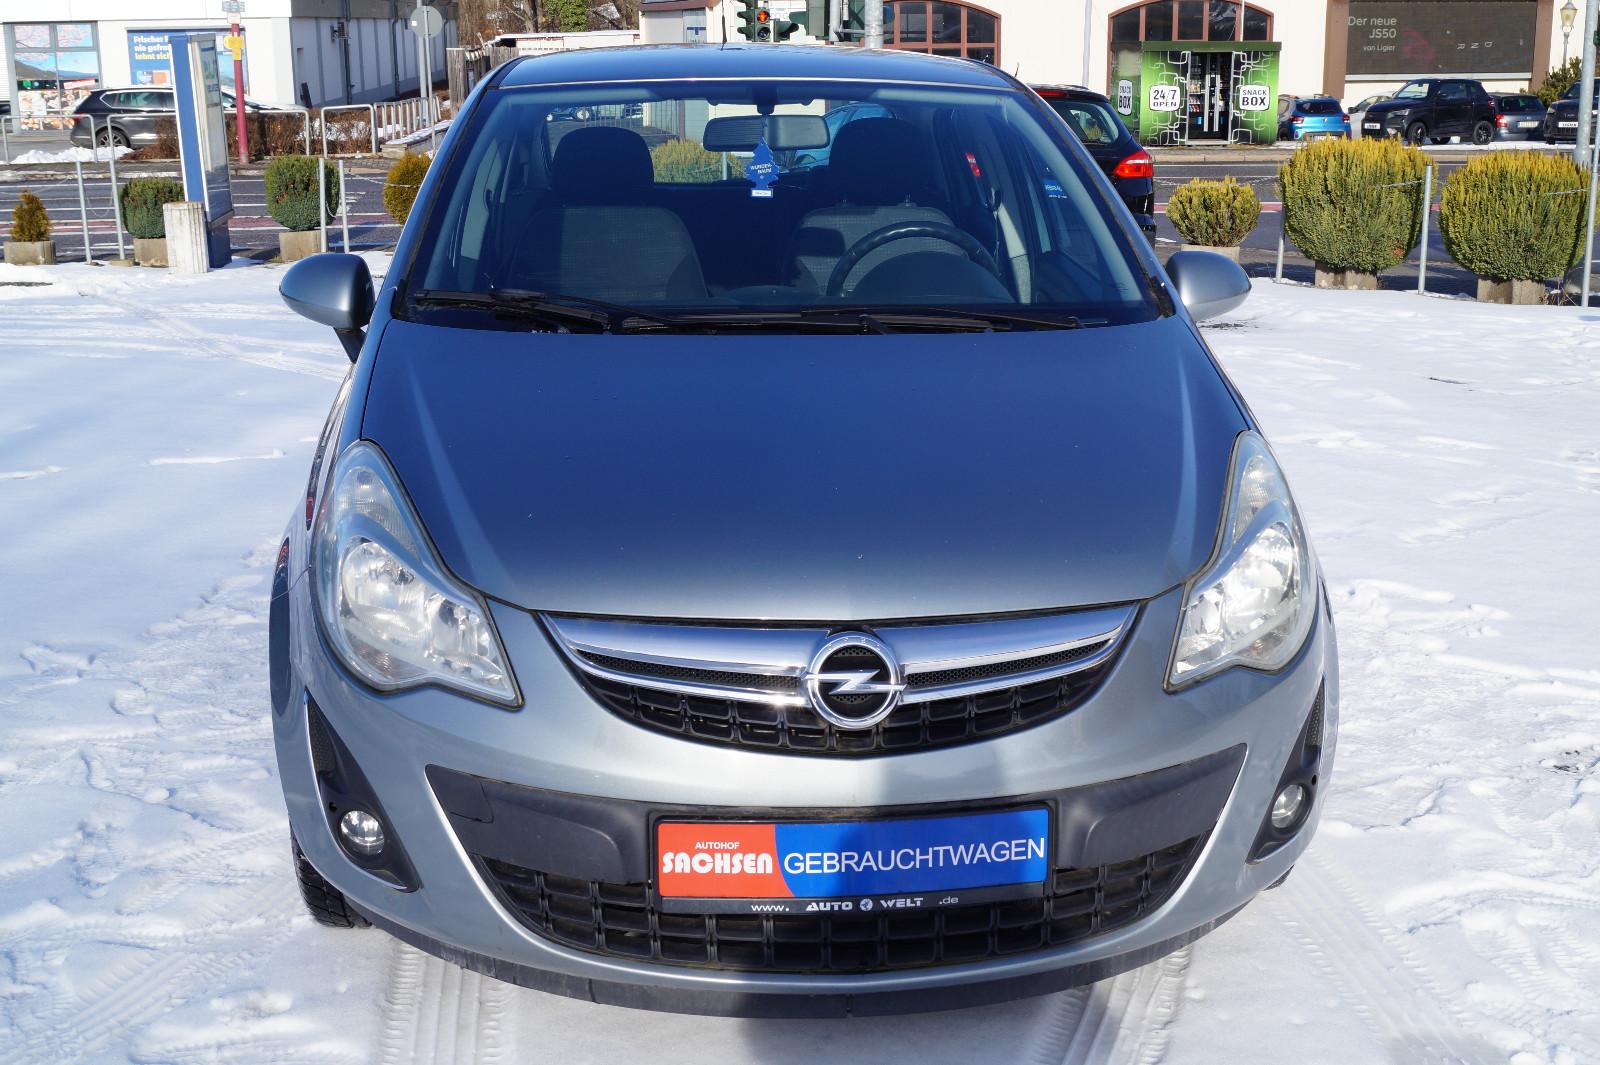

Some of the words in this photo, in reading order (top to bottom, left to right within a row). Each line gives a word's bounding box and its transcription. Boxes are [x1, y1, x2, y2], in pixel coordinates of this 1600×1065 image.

[1348, 16, 1367, 26] Der
[1370, 18, 1397, 26] neue
[133, 35, 164, 43] Frischer
[1369, 28, 1397, 39] JS50
[1153, 89, 1177, 100] 24/7
[1118, 95, 1131, 109] BOX
[1242, 96, 1266, 106] BOX
[694, 841, 740, 850] AUTOHOF
[783, 837, 1045, 875] GEBRAUCHTWAGEN
[662, 851, 774, 875] SACHSEN
[750, 904, 790, 912] www.
[805, 901, 853, 912] AUTO
[880, 897, 923, 908] WELT
